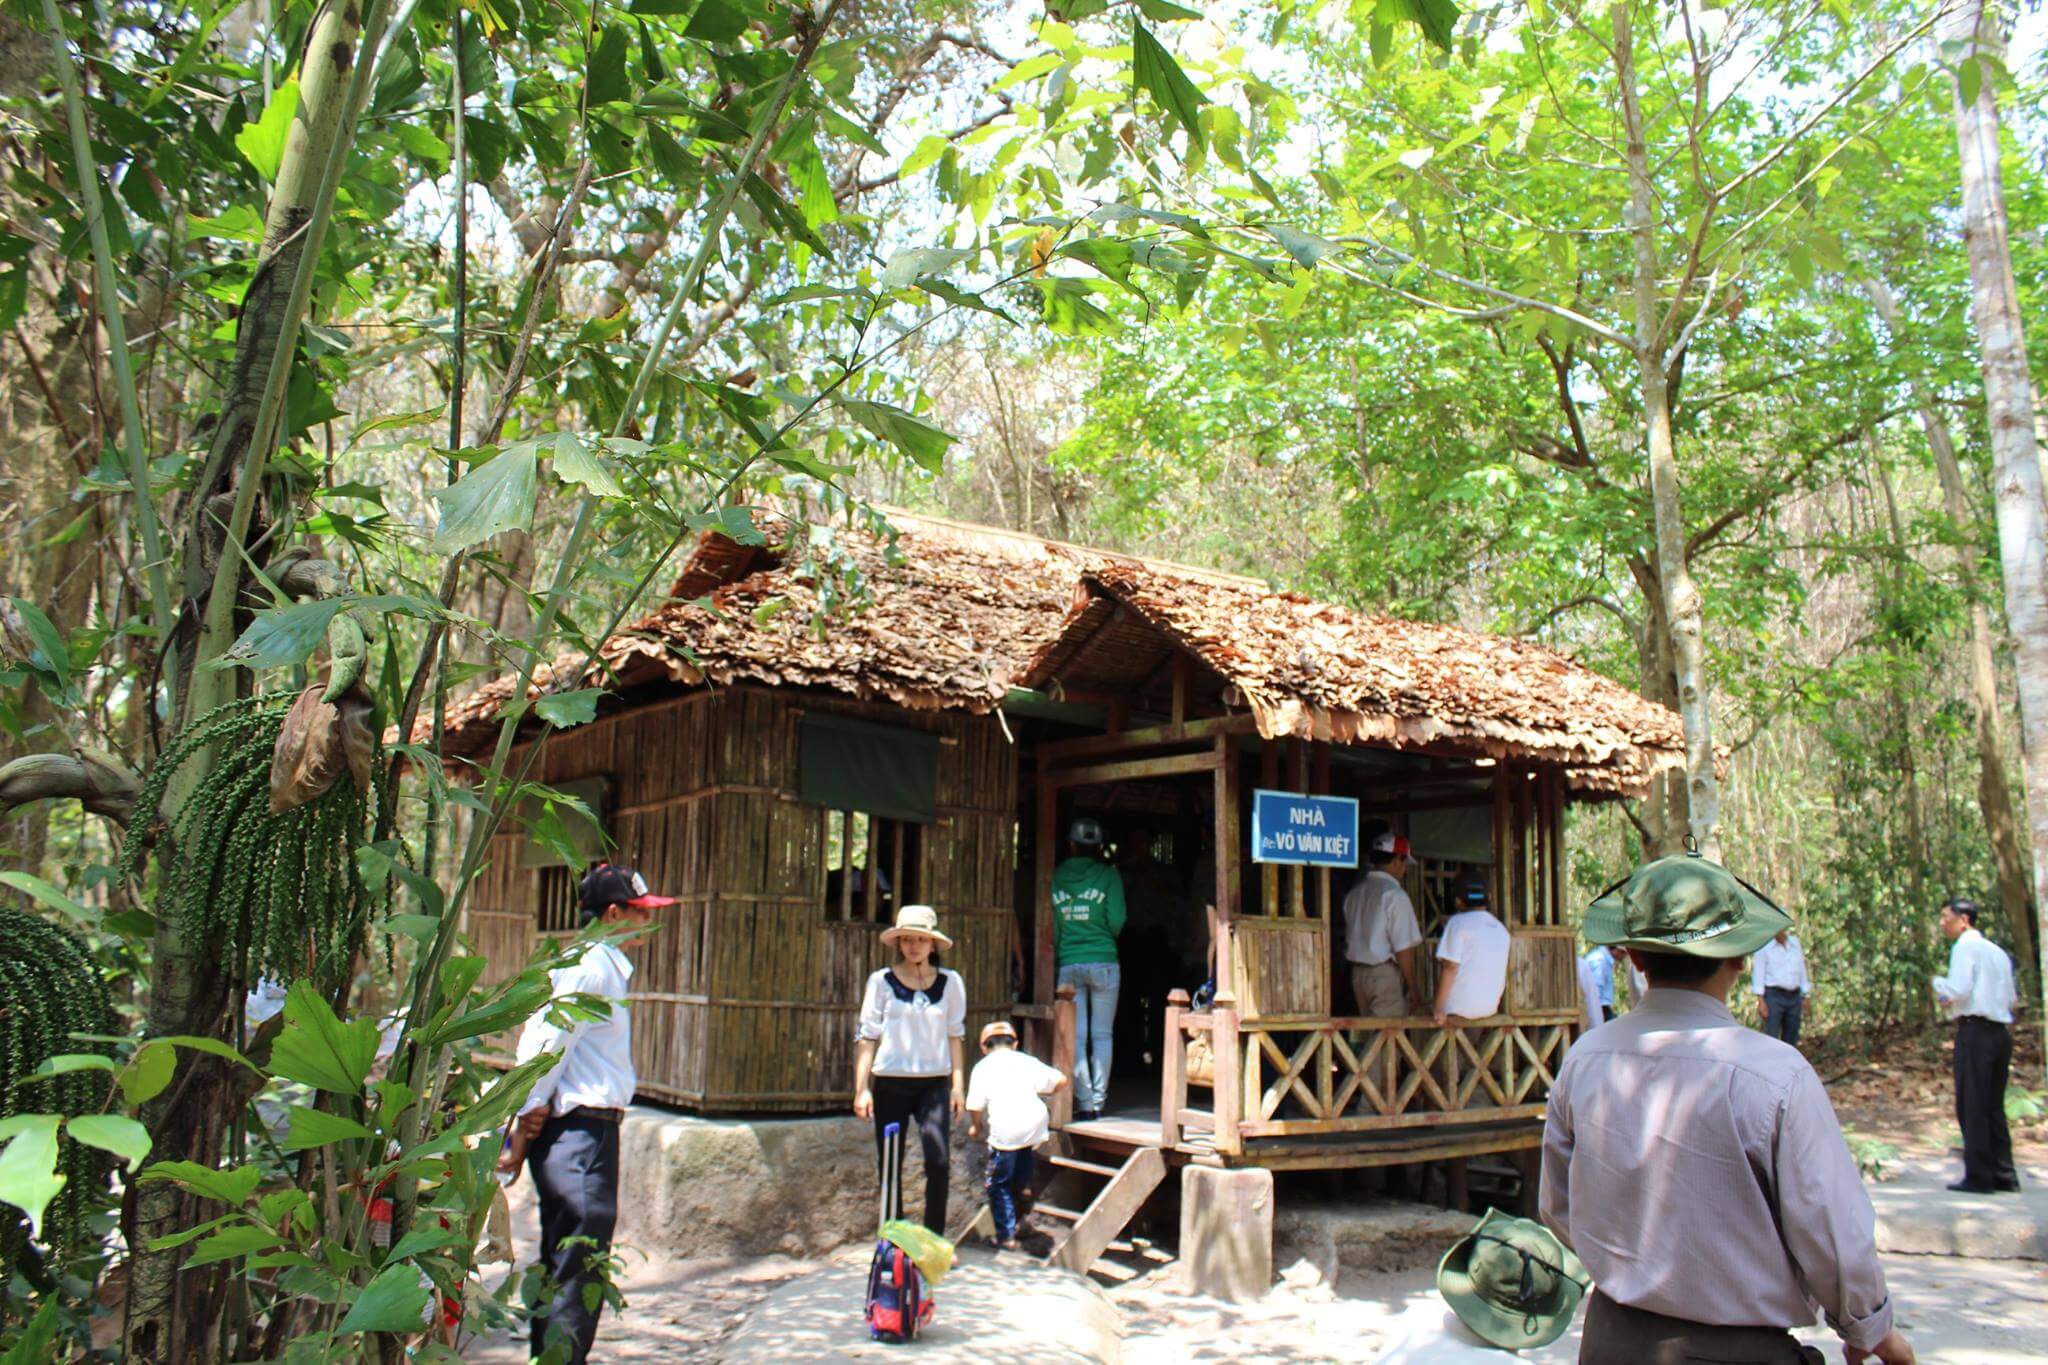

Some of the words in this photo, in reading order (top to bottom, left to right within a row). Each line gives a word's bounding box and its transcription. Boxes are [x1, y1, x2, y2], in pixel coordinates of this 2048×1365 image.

[1290, 805, 1325, 827] NHÀ
[1276, 830, 1295, 851] VÕ
[1297, 832, 1322, 853] VĂN
[1325, 834, 1350, 858] KIỆT
